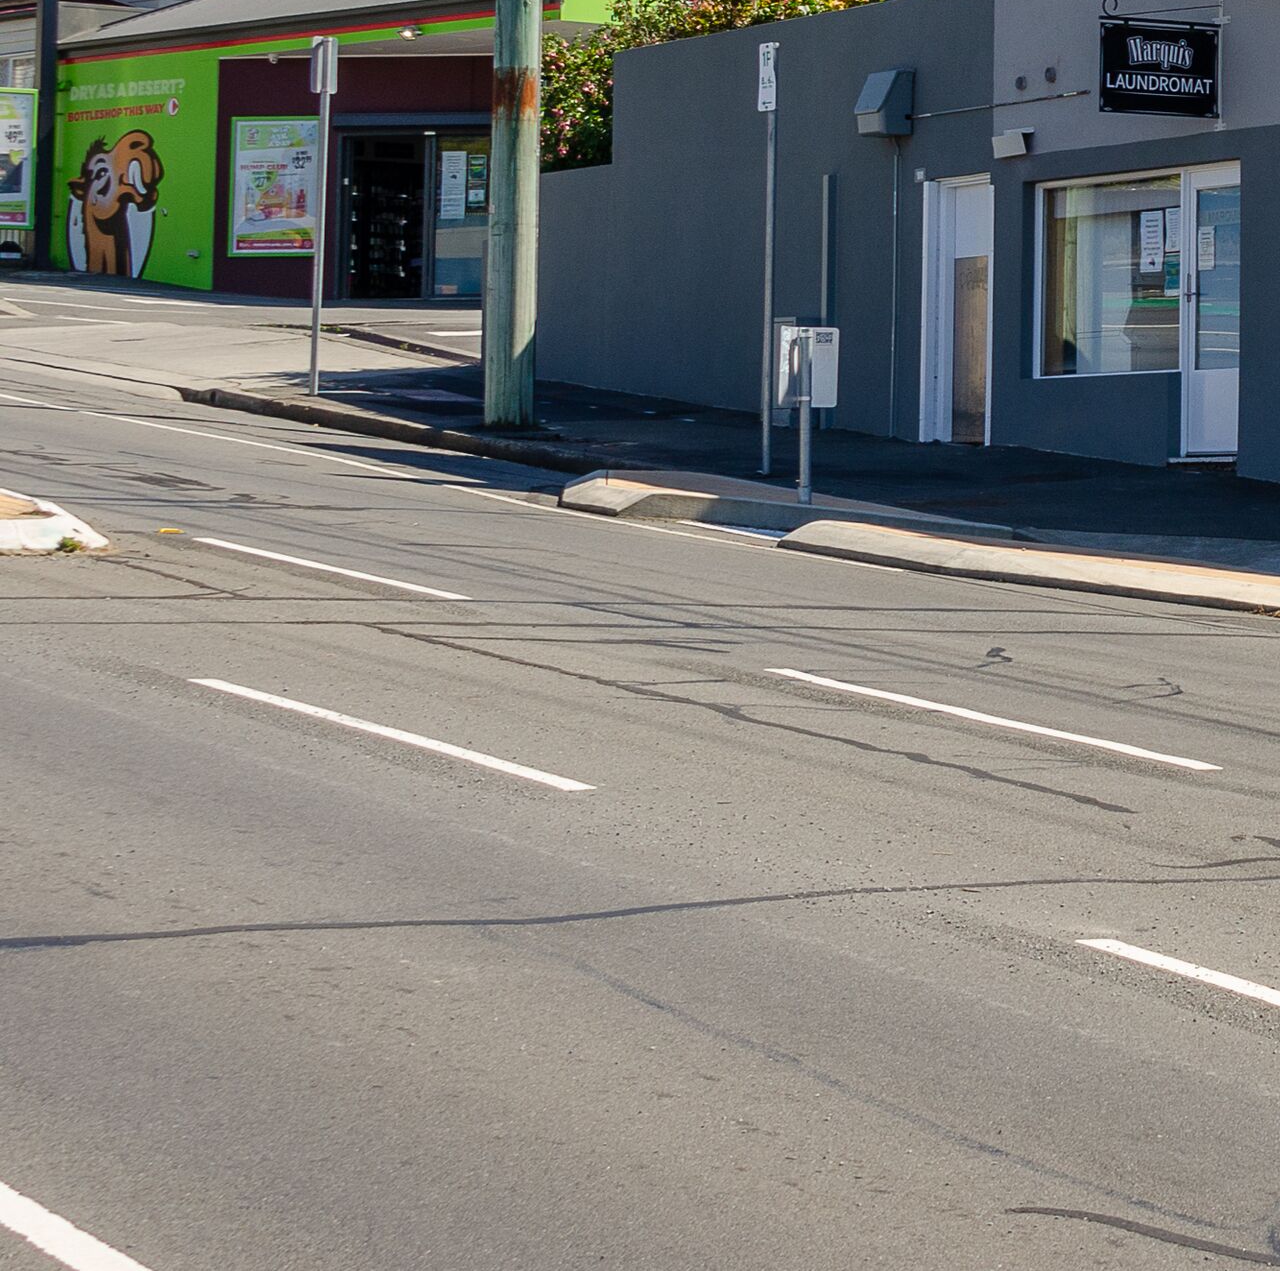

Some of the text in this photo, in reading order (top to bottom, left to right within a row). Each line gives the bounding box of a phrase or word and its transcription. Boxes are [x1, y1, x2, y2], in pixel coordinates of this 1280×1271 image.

[1128, 37, 1193, 69] Marquis
[70, 78, 186, 101] DRY AS A DESERT?
[1106, 72, 1213, 94] LAUNDROMAT
[67, 103, 165, 123] BOTTLESHOP THIS WAY
